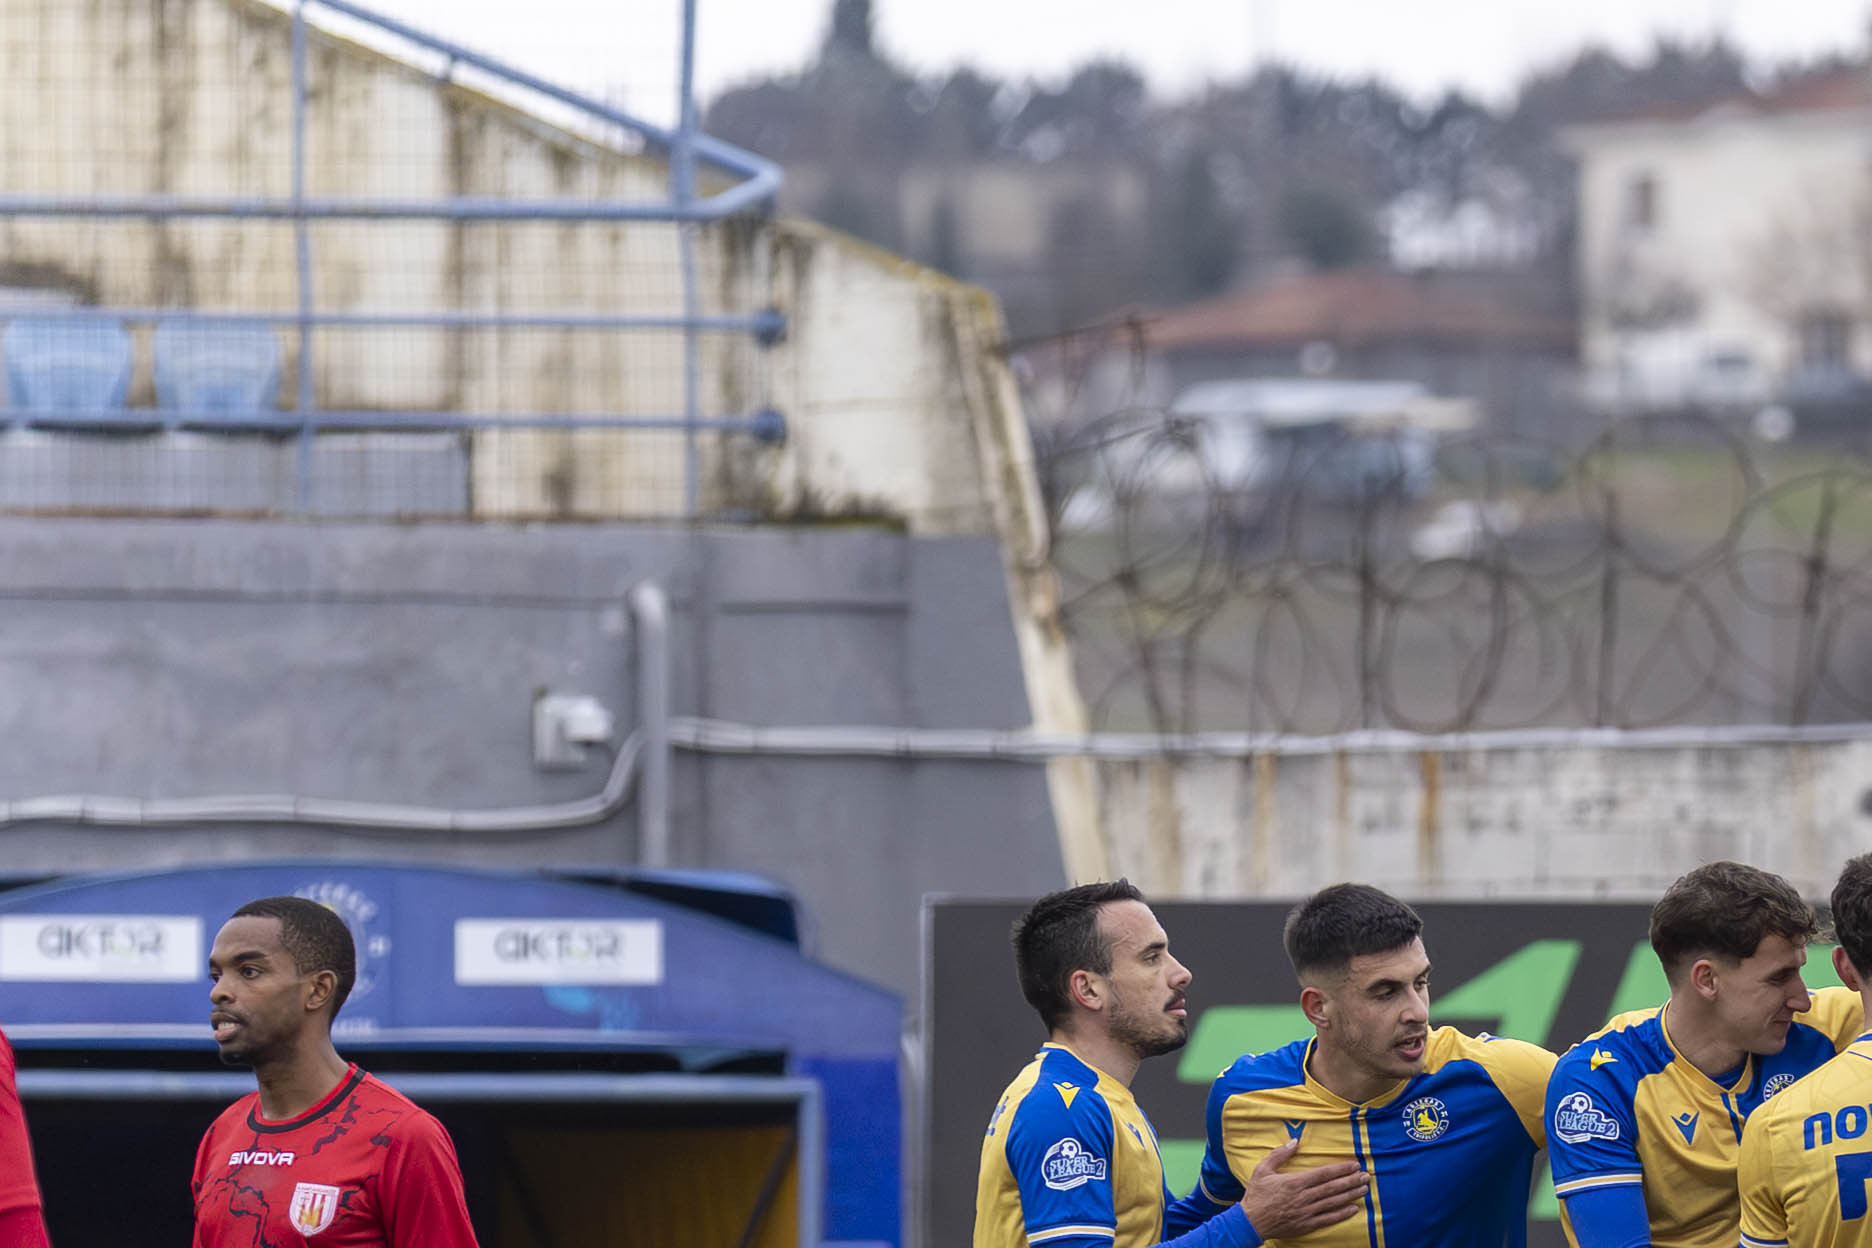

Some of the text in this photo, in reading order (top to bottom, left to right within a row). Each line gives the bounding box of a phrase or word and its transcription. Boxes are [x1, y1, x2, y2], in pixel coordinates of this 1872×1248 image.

[1560, 1111, 1598, 1124] SUPER
[1559, 1120, 1617, 1136] LEAGUE 2
[1049, 1156, 1089, 1170] SUPER
[1049, 1162, 1104, 1180] LEAGUE 2
